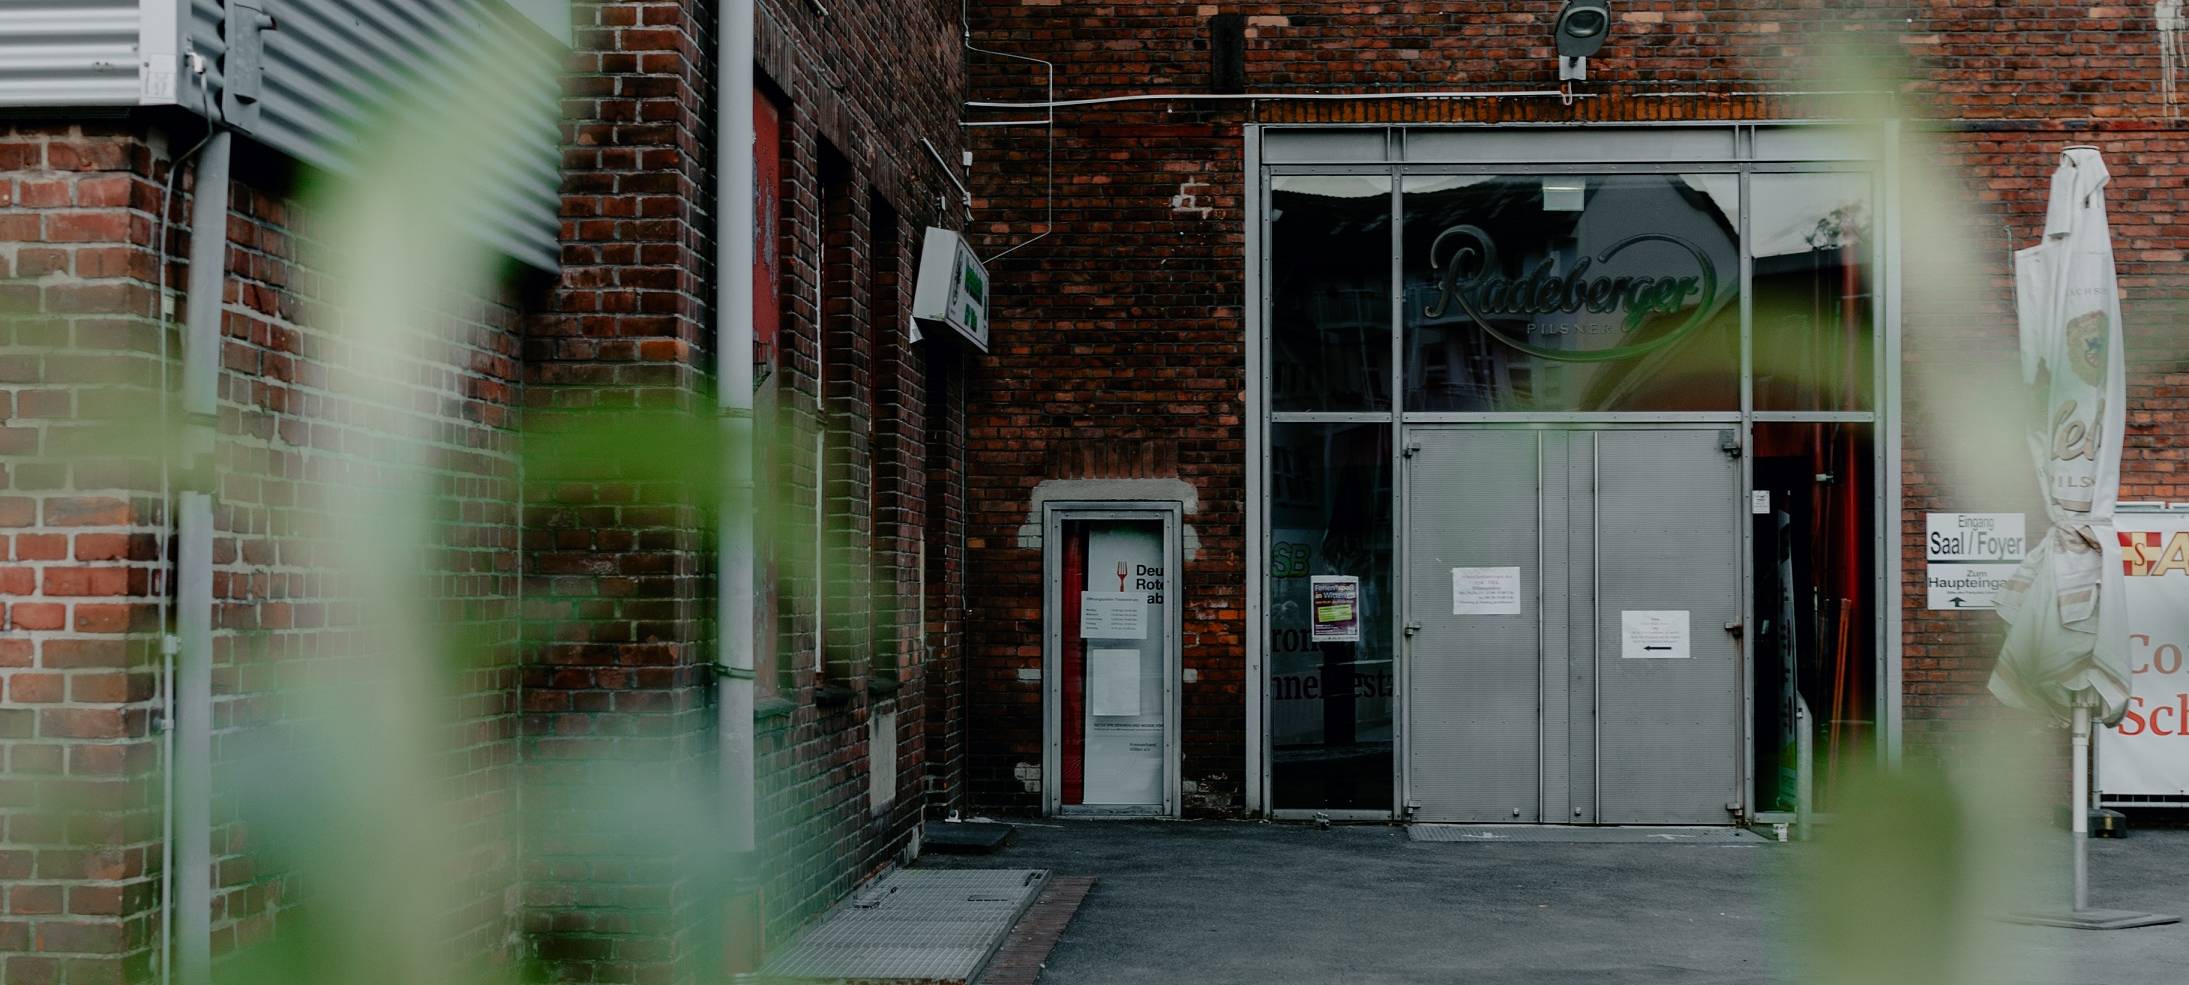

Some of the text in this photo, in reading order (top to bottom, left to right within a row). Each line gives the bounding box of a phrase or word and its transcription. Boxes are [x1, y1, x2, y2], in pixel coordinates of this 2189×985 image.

[1424, 224, 1699, 333] Radeberger
[1527, 323, 1611, 335] PILSNER
[1958, 515, 1994, 531] Eingang
[1930, 531, 1964, 555] Saal
[1978, 531, 2022, 560] Foyer
[1966, 569, 1987, 577] Zum
